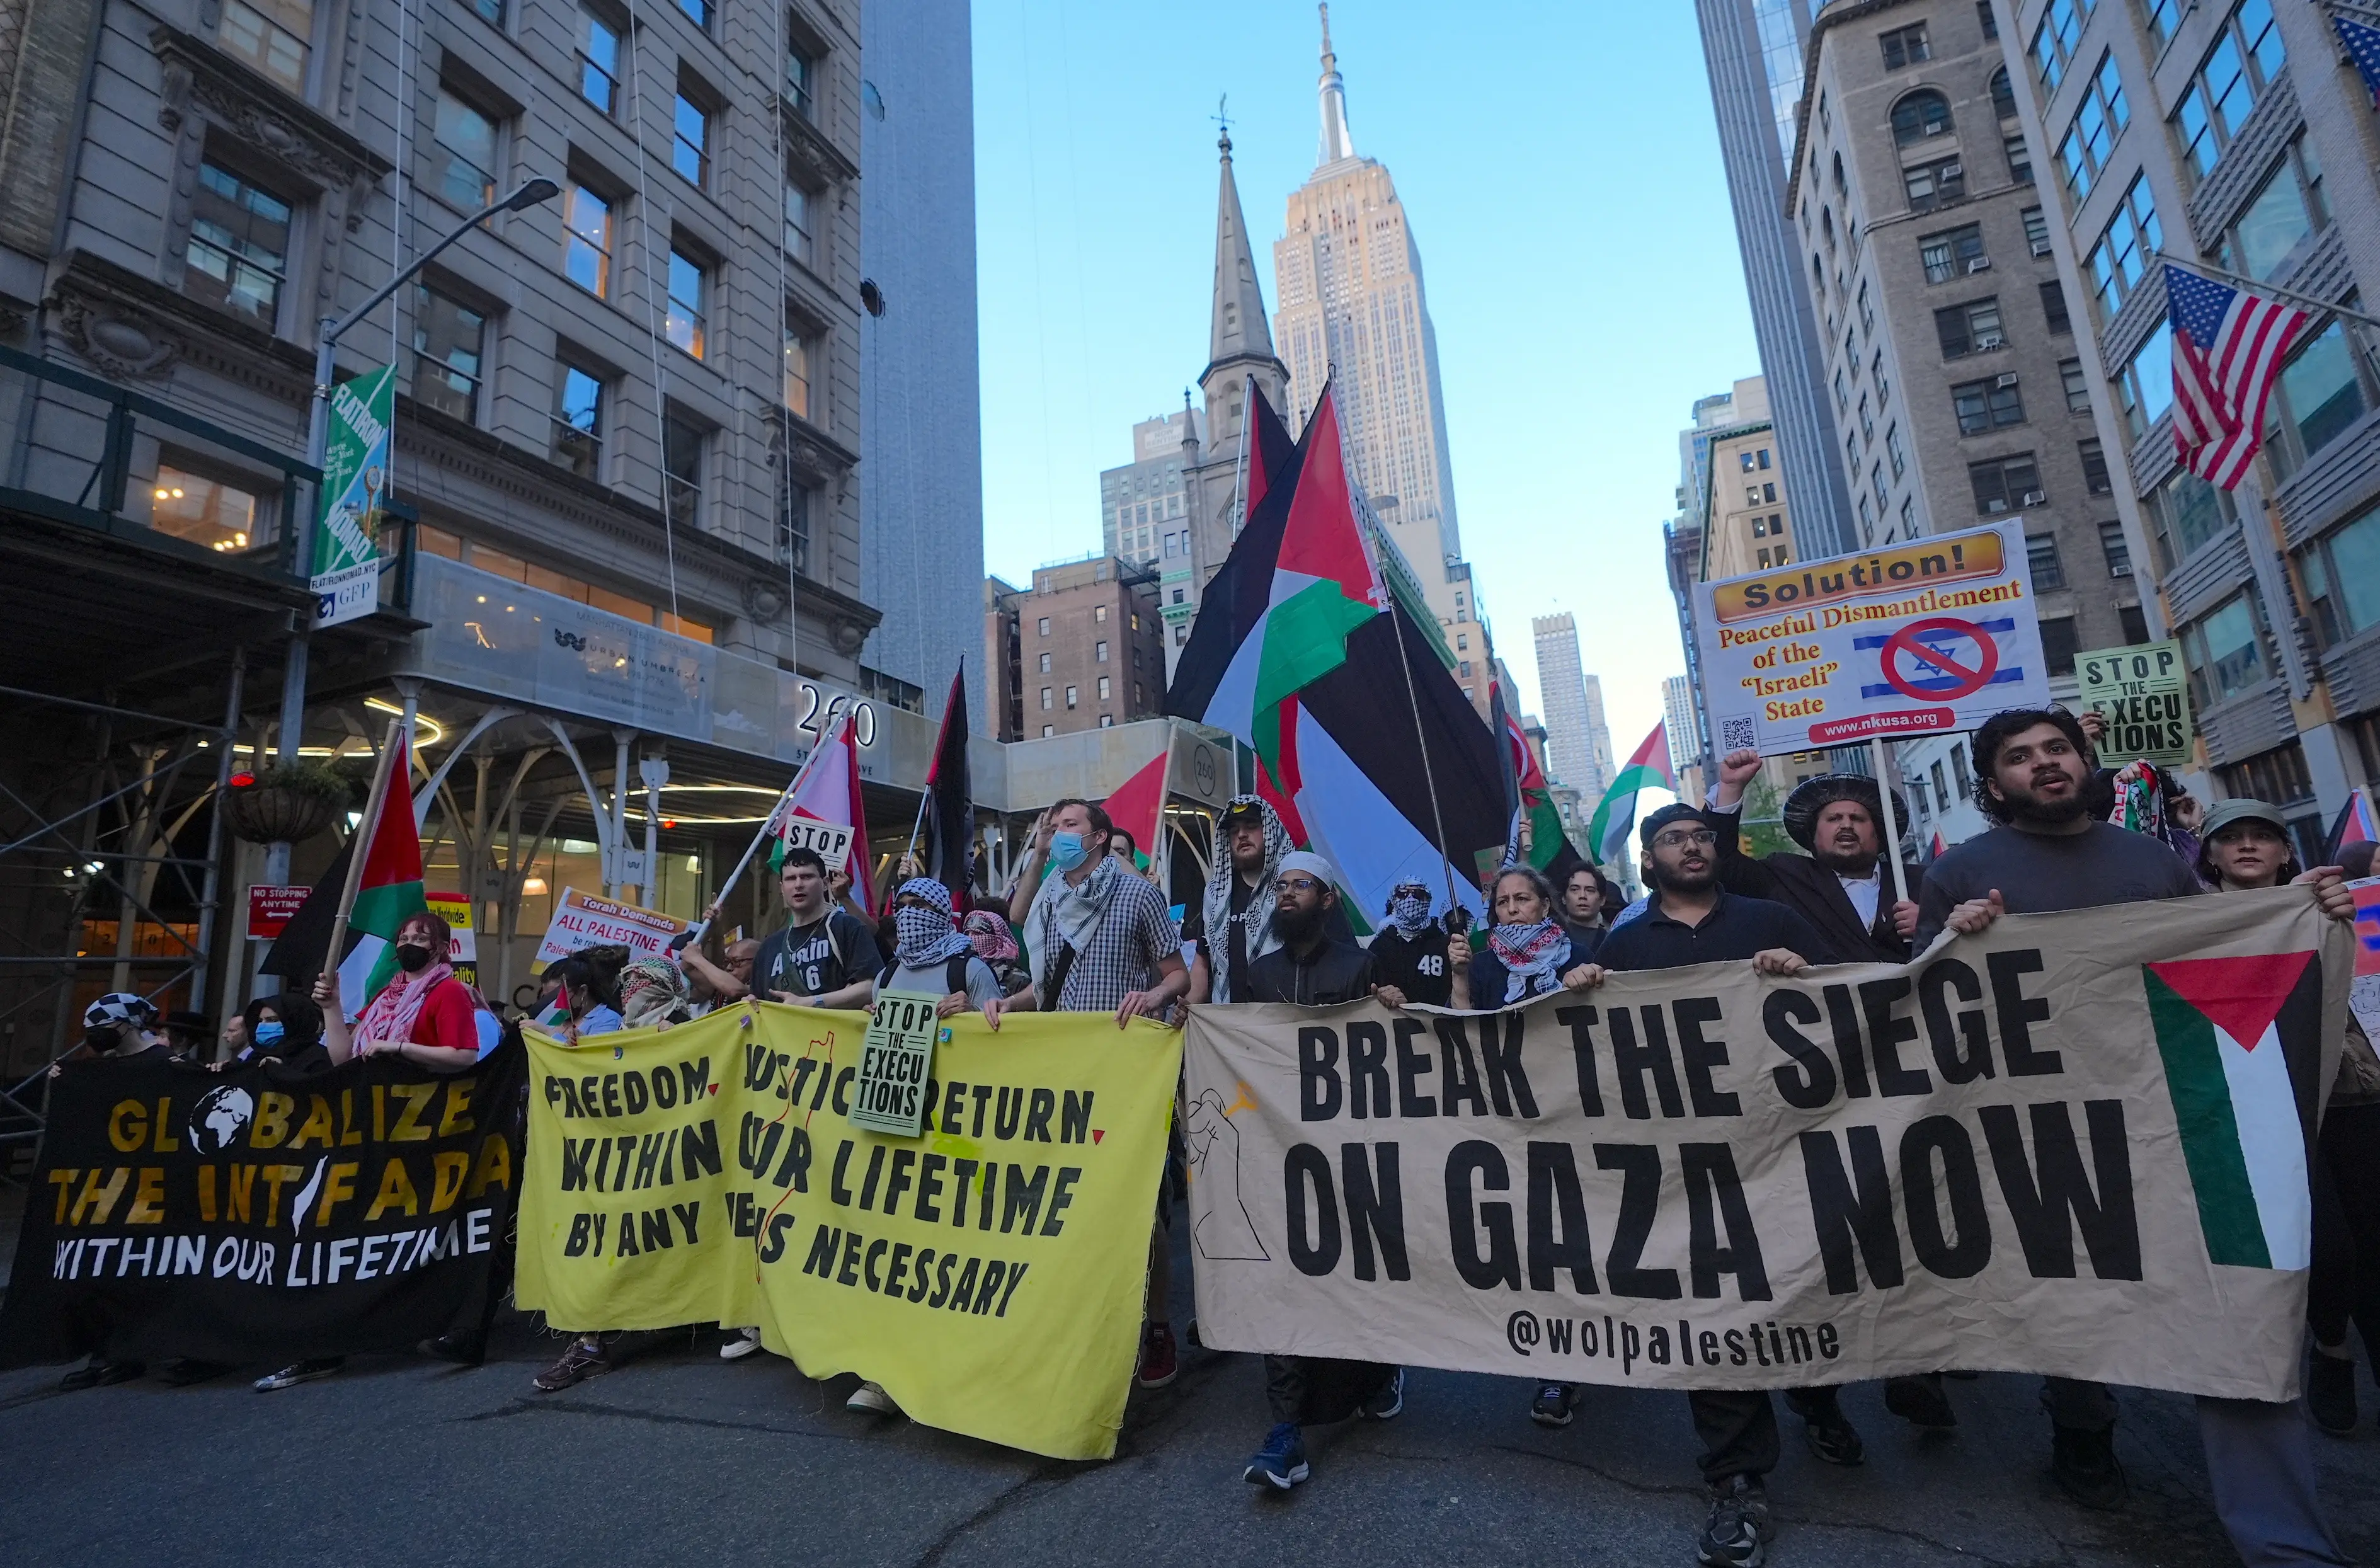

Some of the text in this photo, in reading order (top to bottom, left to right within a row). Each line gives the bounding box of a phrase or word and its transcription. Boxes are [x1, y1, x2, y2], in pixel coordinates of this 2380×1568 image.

[331, 382, 389, 448] FLATIRON
[324, 502, 371, 564] NOMAD
[340, 582, 370, 605] GFP
[1744, 544, 1964, 609] Solution!
[1720, 579, 2022, 649] Peaceful Dismantlement
[1753, 641, 1820, 670] of the
[2086, 651, 2174, 685] STOP
[2119, 681, 2147, 696] THE
[1766, 697, 1824, 721] State
[1824, 712, 1938, 736] www.nkusa.org
[1197, 761, 1213, 780] 260
[789, 825, 846, 854] STOP
[253, 890, 308, 898] NO STOPPING
[260, 900, 300, 908] ANYTIME
[583, 896, 675, 931] Torah Demands
[557, 915, 660, 951] ALL PALESTINE
[573, 936, 583, 946] be
[1417, 954, 1443, 977] 48
[874, 1000, 933, 1032] STOP
[888, 1031, 906, 1050] THE
[1298, 948, 2064, 1121] BREAK THE SIEGE
[862, 1047, 924, 1084] EXECU
[859, 1079, 918, 1117] TIONS
[561, 1119, 723, 1193] WITHIN
[739, 1111, 813, 1193] OUR
[831, 1140, 1082, 1237] LIFETIME
[48, 1167, 169, 1226] THE
[1284, 1099, 2143, 1302] ON GAZA NOW
[53, 1208, 493, 1287] WITHIN OUR LIFETIME
[564, 1213, 607, 1257] BY
[617, 1201, 699, 1257] ANY
[803, 1224, 1029, 1317] NECESSARY
[1507, 1310, 1840, 1376] @wolpalestine
